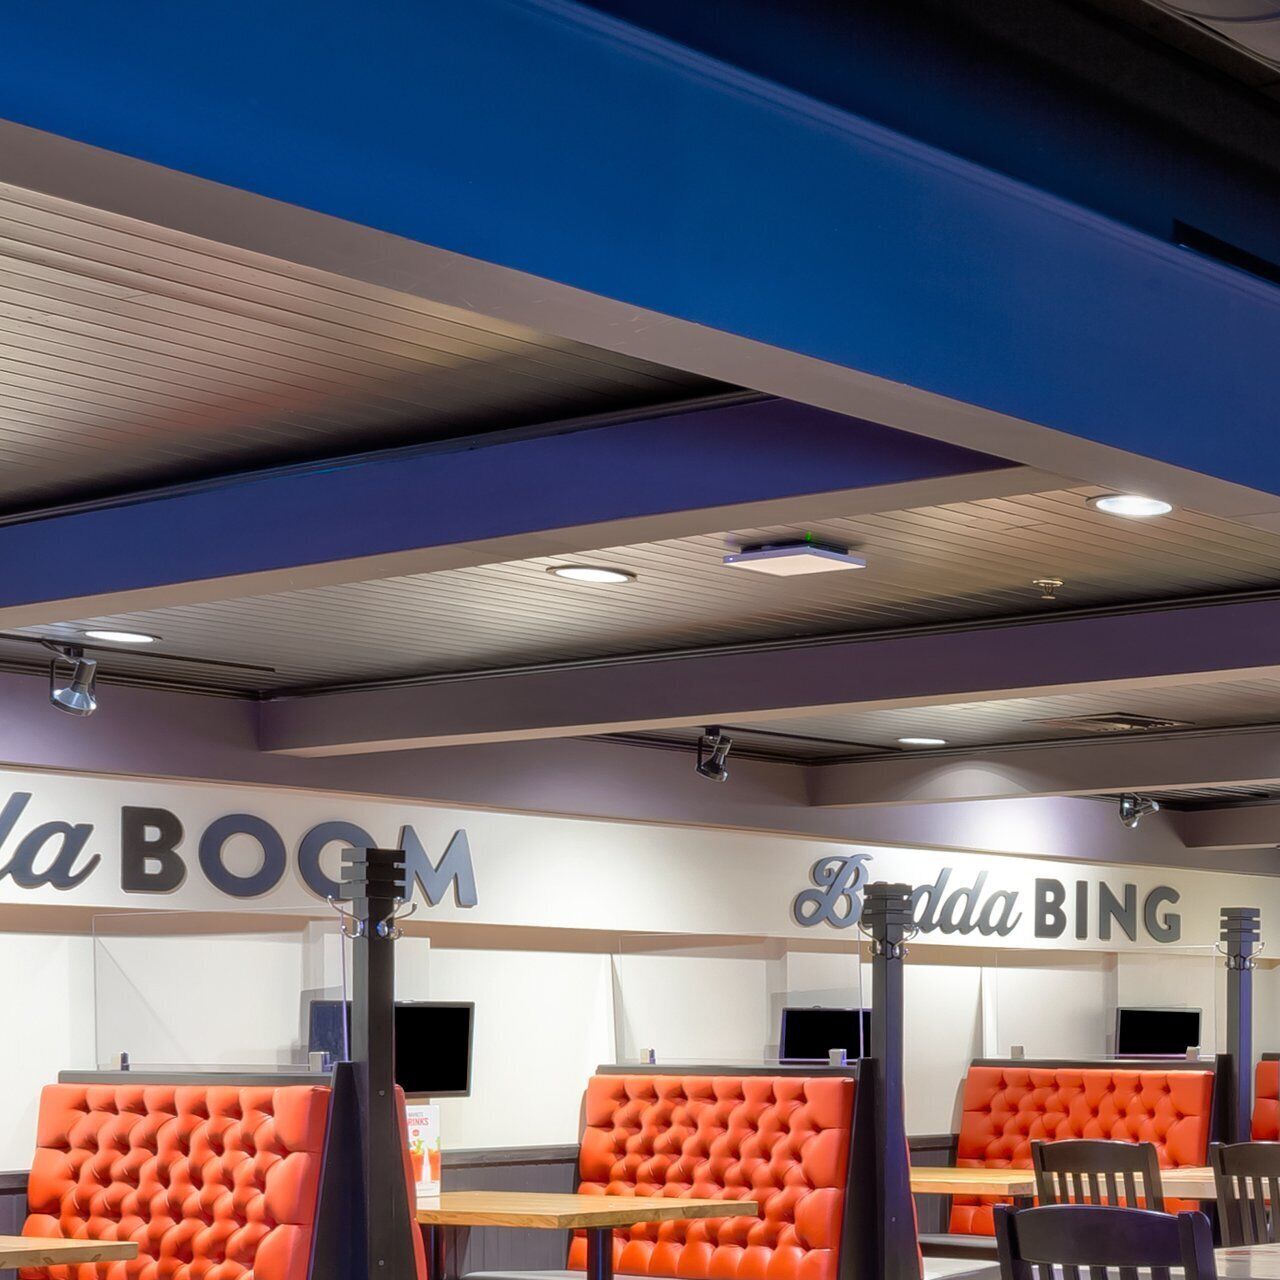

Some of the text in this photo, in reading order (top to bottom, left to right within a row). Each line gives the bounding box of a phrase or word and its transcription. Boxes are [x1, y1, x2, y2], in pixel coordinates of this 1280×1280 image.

[121, 806, 477, 908] BOOM
[792, 854, 1181, 943] Bdda BING
[407, 1117, 429, 1126] RINKS
